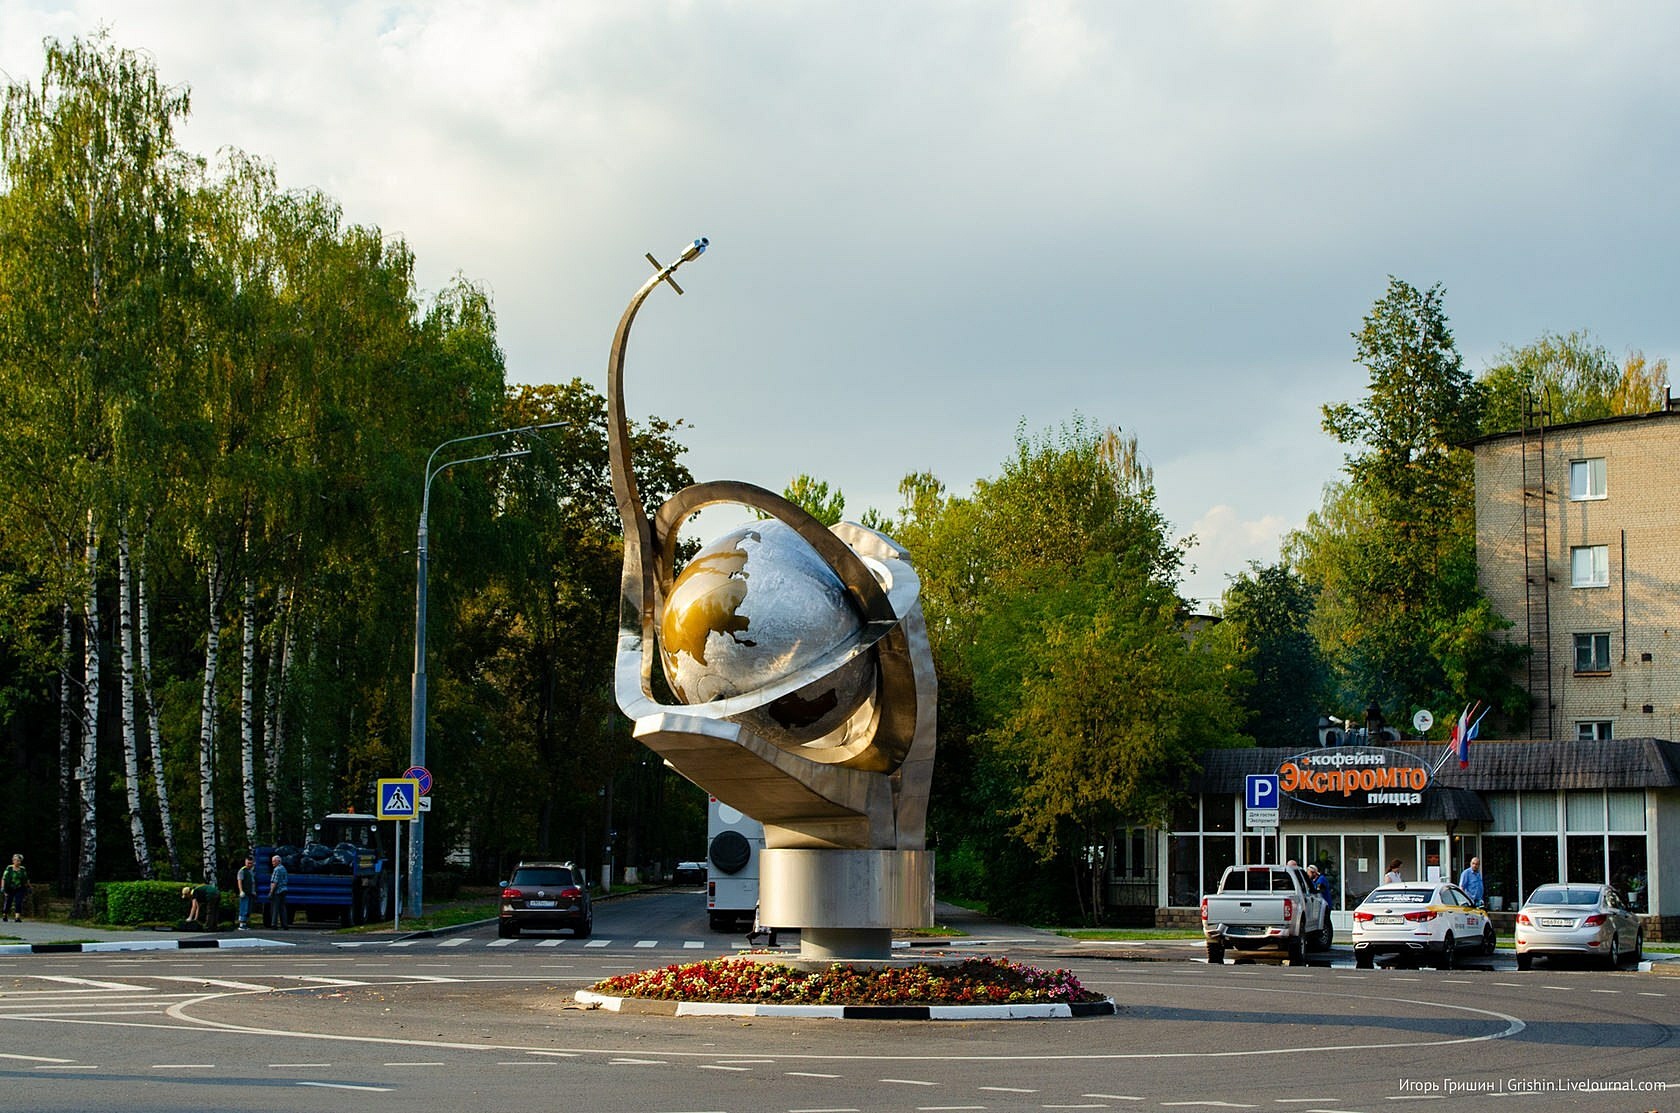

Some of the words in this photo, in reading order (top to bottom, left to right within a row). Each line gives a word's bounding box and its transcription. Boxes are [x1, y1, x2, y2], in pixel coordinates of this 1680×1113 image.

[1311, 752, 1385, 768] кофейня
[1280, 763, 1427, 797] Экспромто
[1367, 792, 1422, 806] пицца
